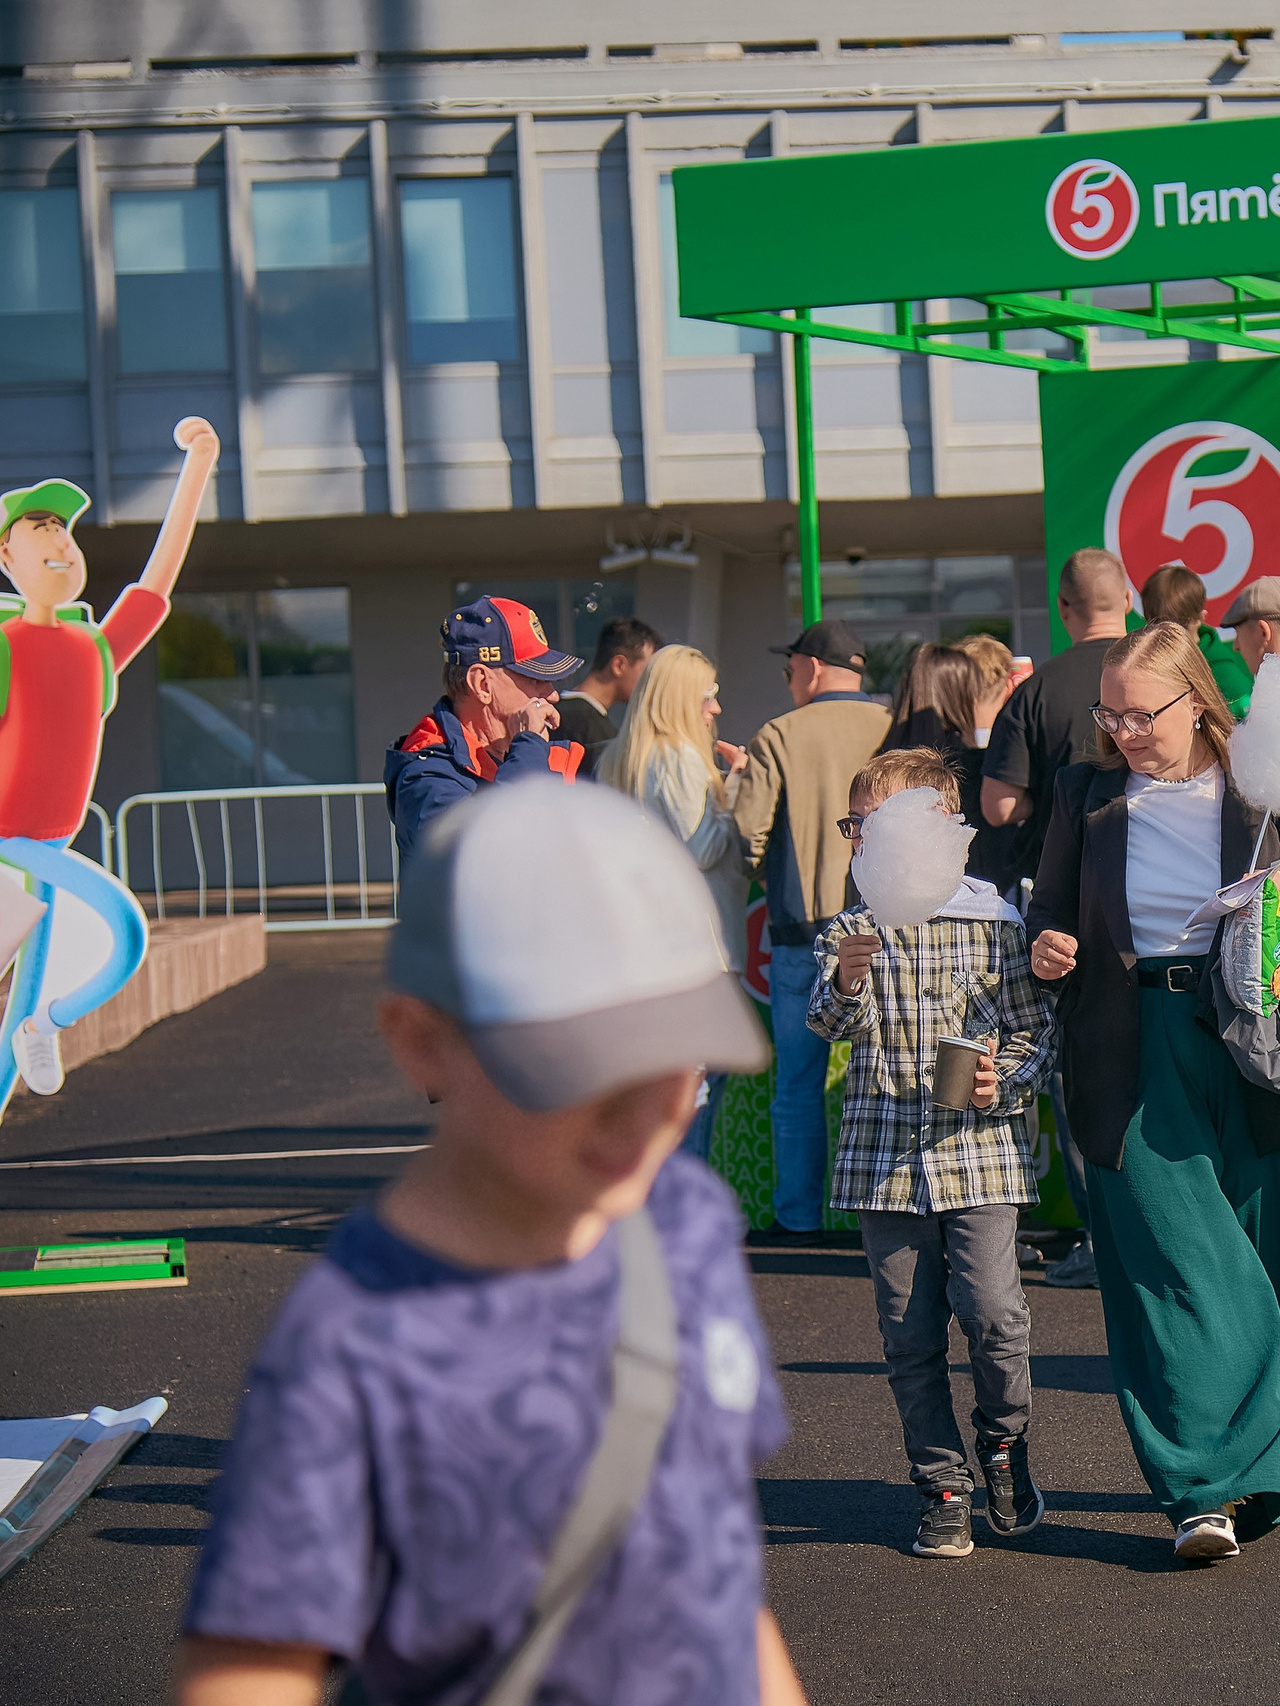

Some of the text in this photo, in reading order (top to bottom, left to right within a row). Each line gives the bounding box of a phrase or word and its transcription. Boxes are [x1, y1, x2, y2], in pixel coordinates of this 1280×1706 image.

[1071, 166, 1117, 241] 5
[1161, 436, 1262, 600] 5
[479, 647, 501, 662] 85
